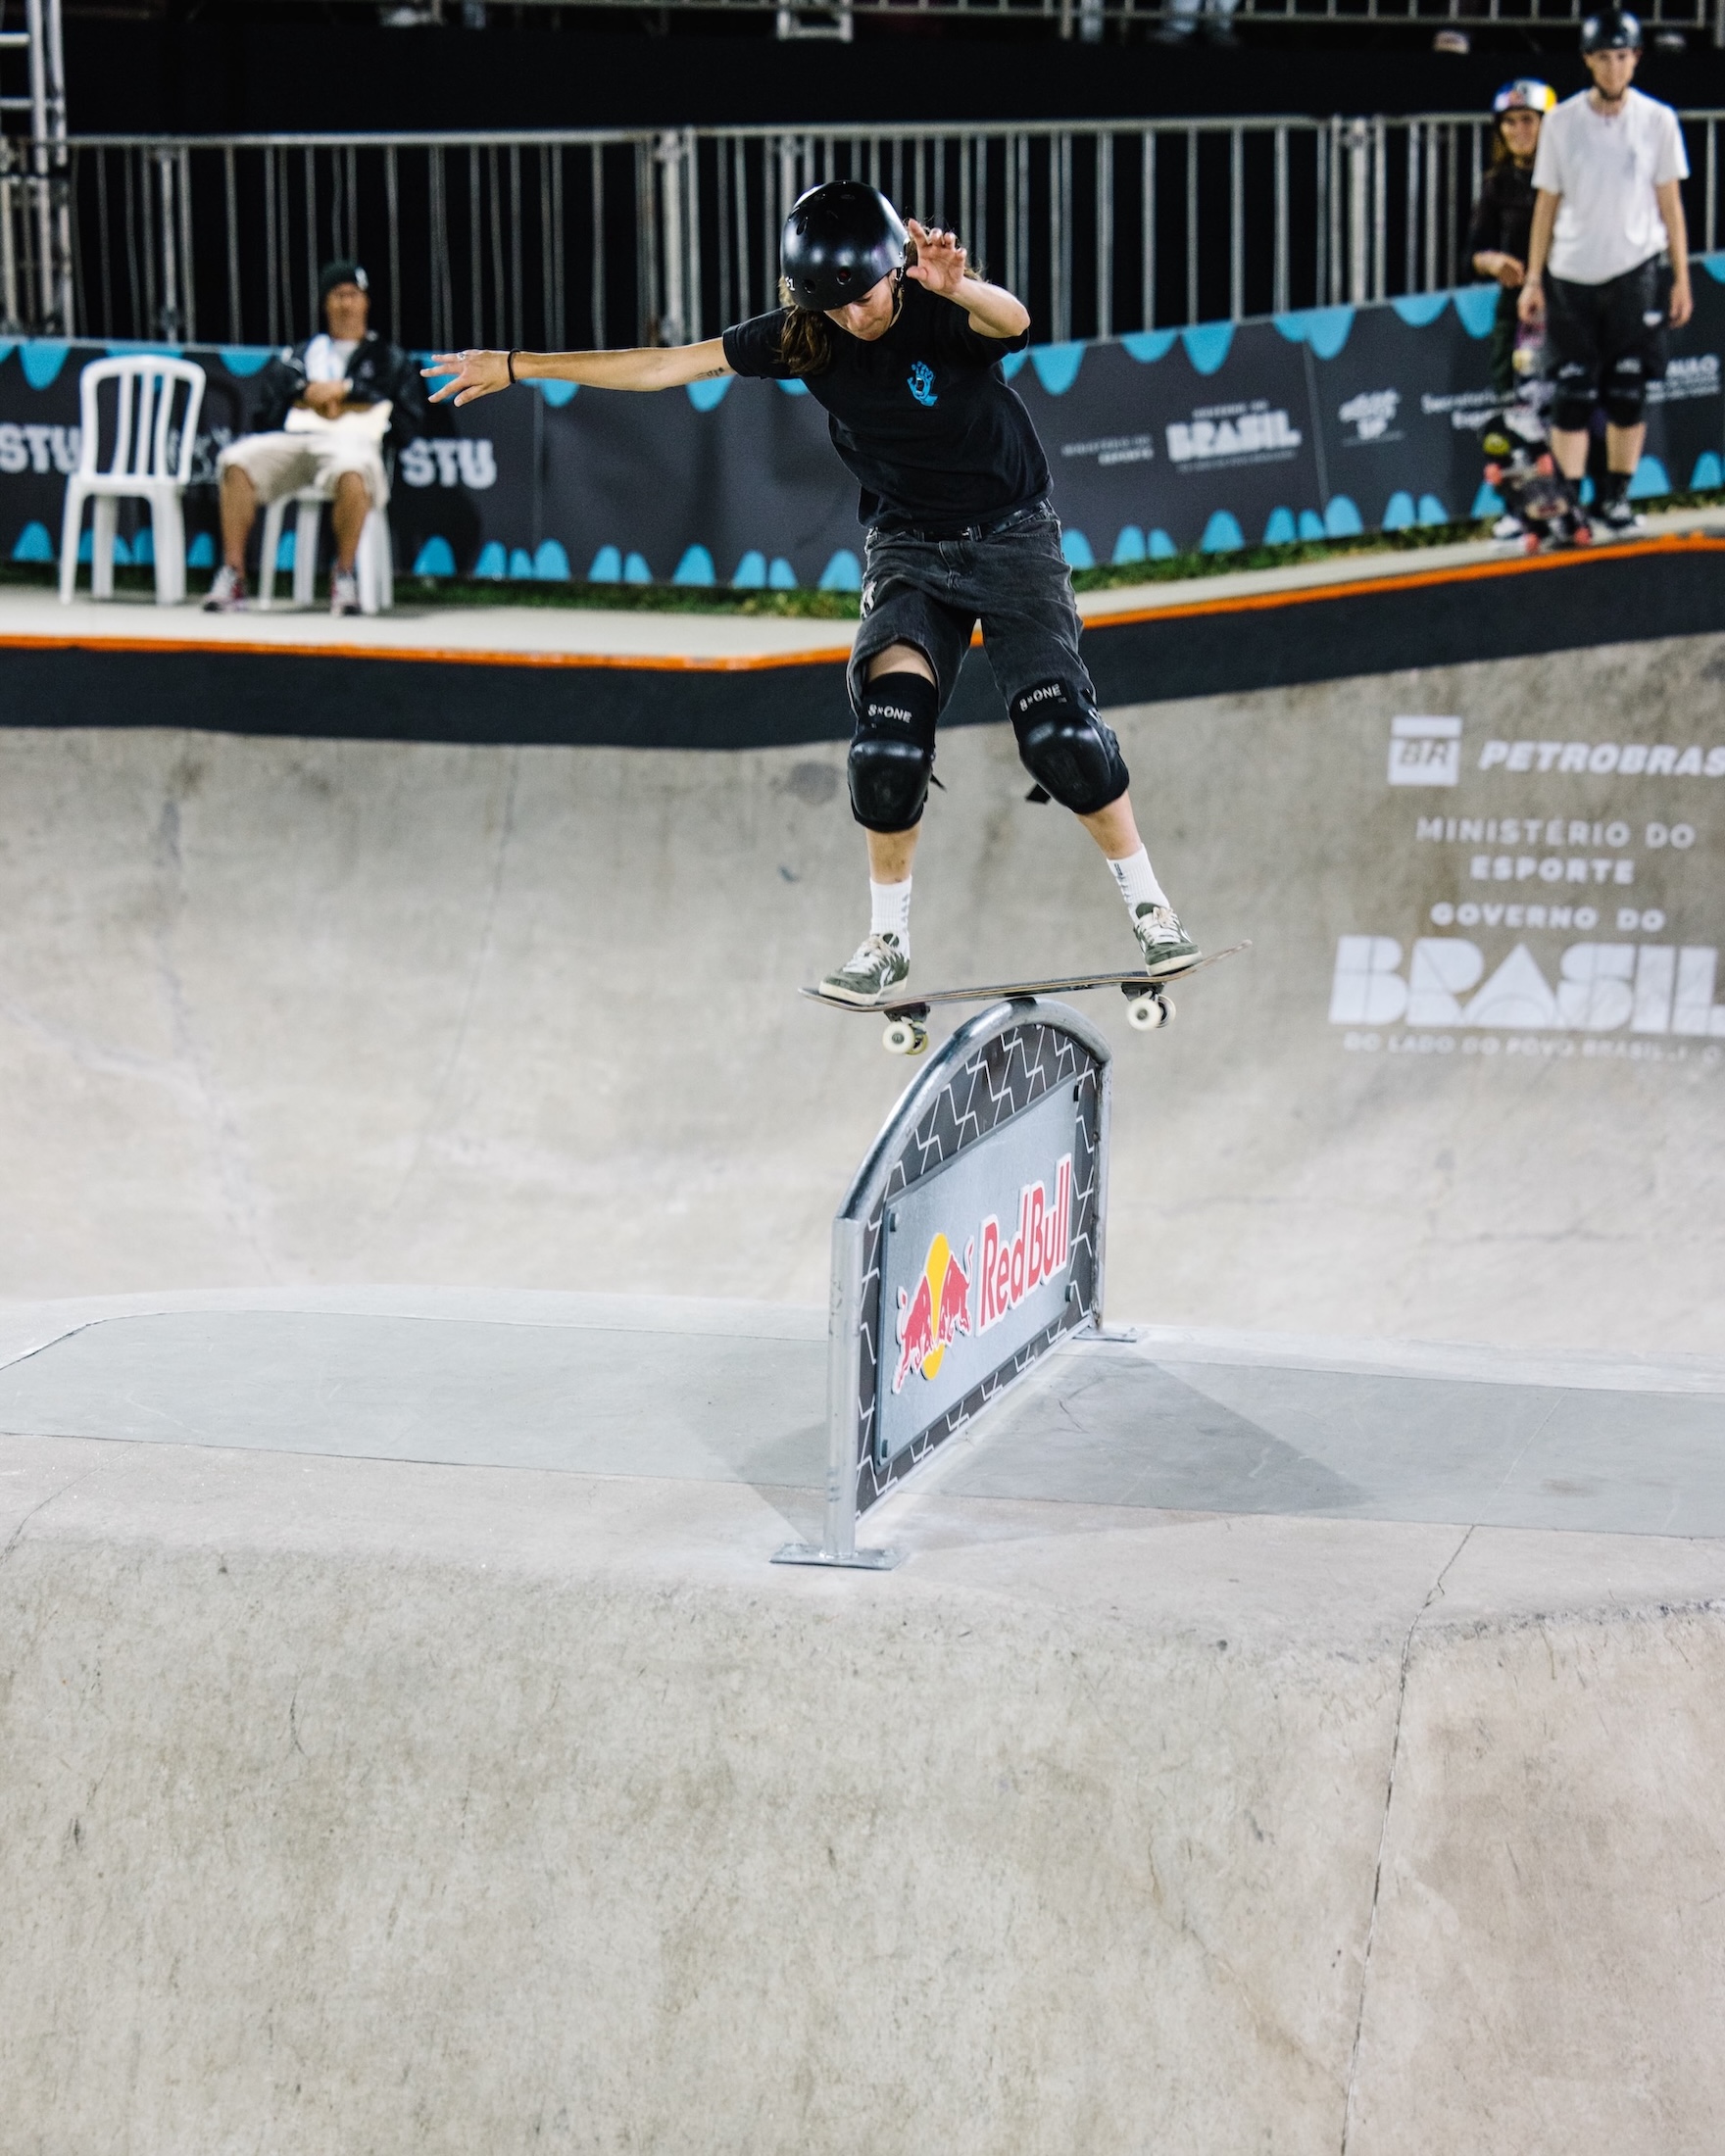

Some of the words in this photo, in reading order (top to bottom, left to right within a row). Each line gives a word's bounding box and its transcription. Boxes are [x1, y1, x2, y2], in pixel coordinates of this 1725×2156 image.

[0, 422, 82, 474] STU
[399, 437, 497, 489] STU
[1478, 740, 1725, 777] PETROBRAS
[1415, 814, 1631, 849] MINISTÉRIO
[1645, 822, 1697, 850] DO
[1470, 855, 1636, 885] ESPORTE
[1429, 901, 1600, 930] GOVERNO
[1615, 906, 1666, 932] DO
[1328, 934, 1725, 1038] BRASIL
